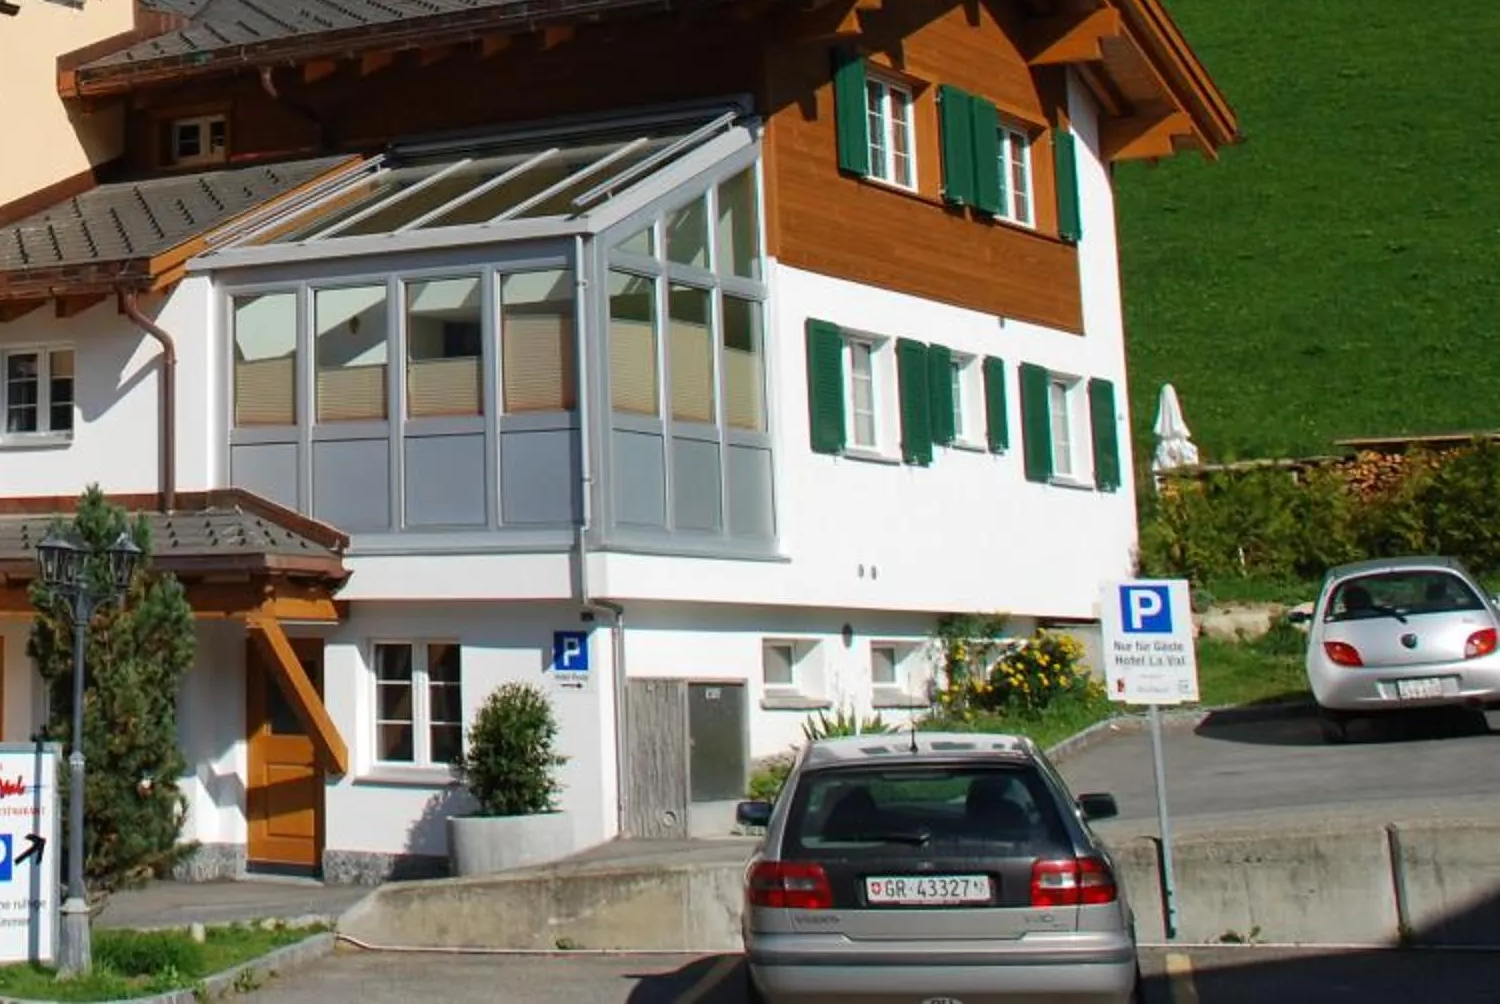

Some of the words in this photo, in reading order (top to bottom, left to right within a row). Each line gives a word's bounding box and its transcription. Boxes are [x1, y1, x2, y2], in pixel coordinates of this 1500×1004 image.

[1129, 589, 1162, 629] P
[563, 637, 581, 666] P
[1113, 640, 1133, 651] Nur
[1115, 655, 1145, 666] Hotel
[1149, 656, 1163, 666] La
[1167, 656, 1185, 666] Val
[885, 879, 907, 897] GR
[917, 879, 970, 897] 43327
